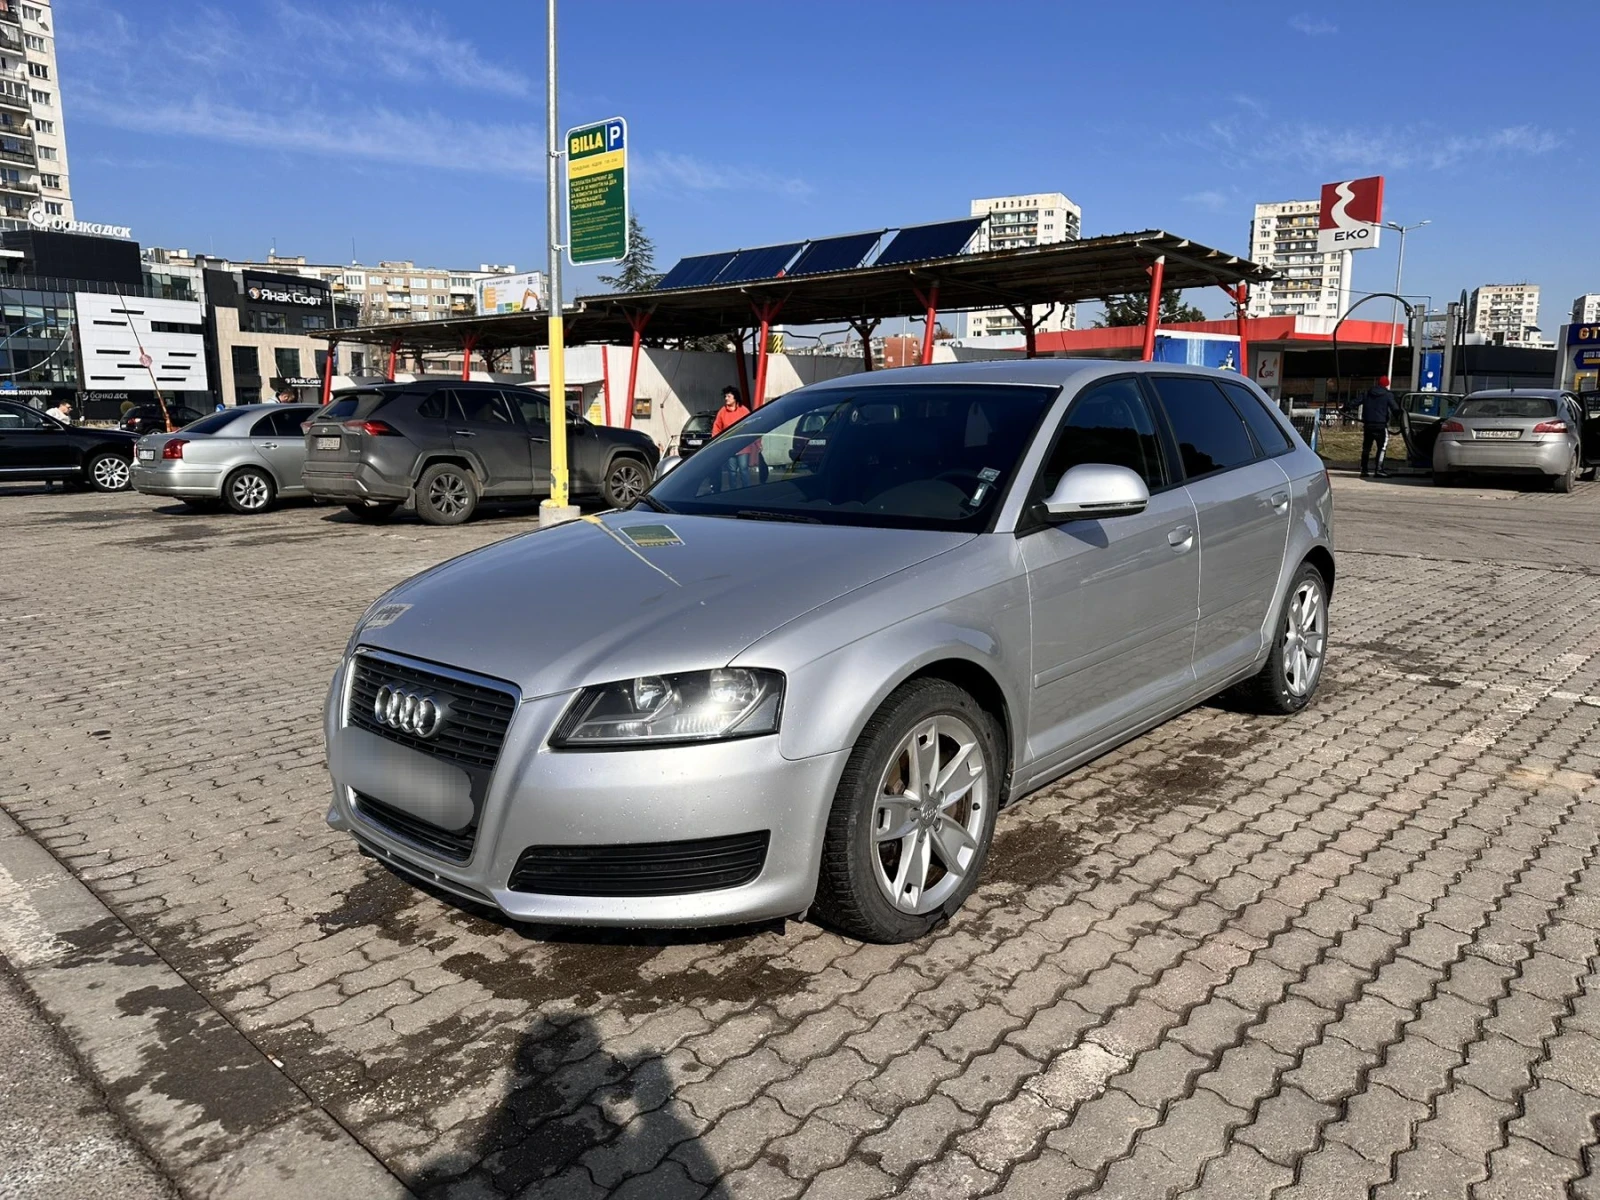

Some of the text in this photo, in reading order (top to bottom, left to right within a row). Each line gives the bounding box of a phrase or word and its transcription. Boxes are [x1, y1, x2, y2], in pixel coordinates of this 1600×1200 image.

[571, 126, 620, 154] BILLA P
[1334, 229, 1369, 241] EKO
[261, 289, 322, 306] Янак Софт
